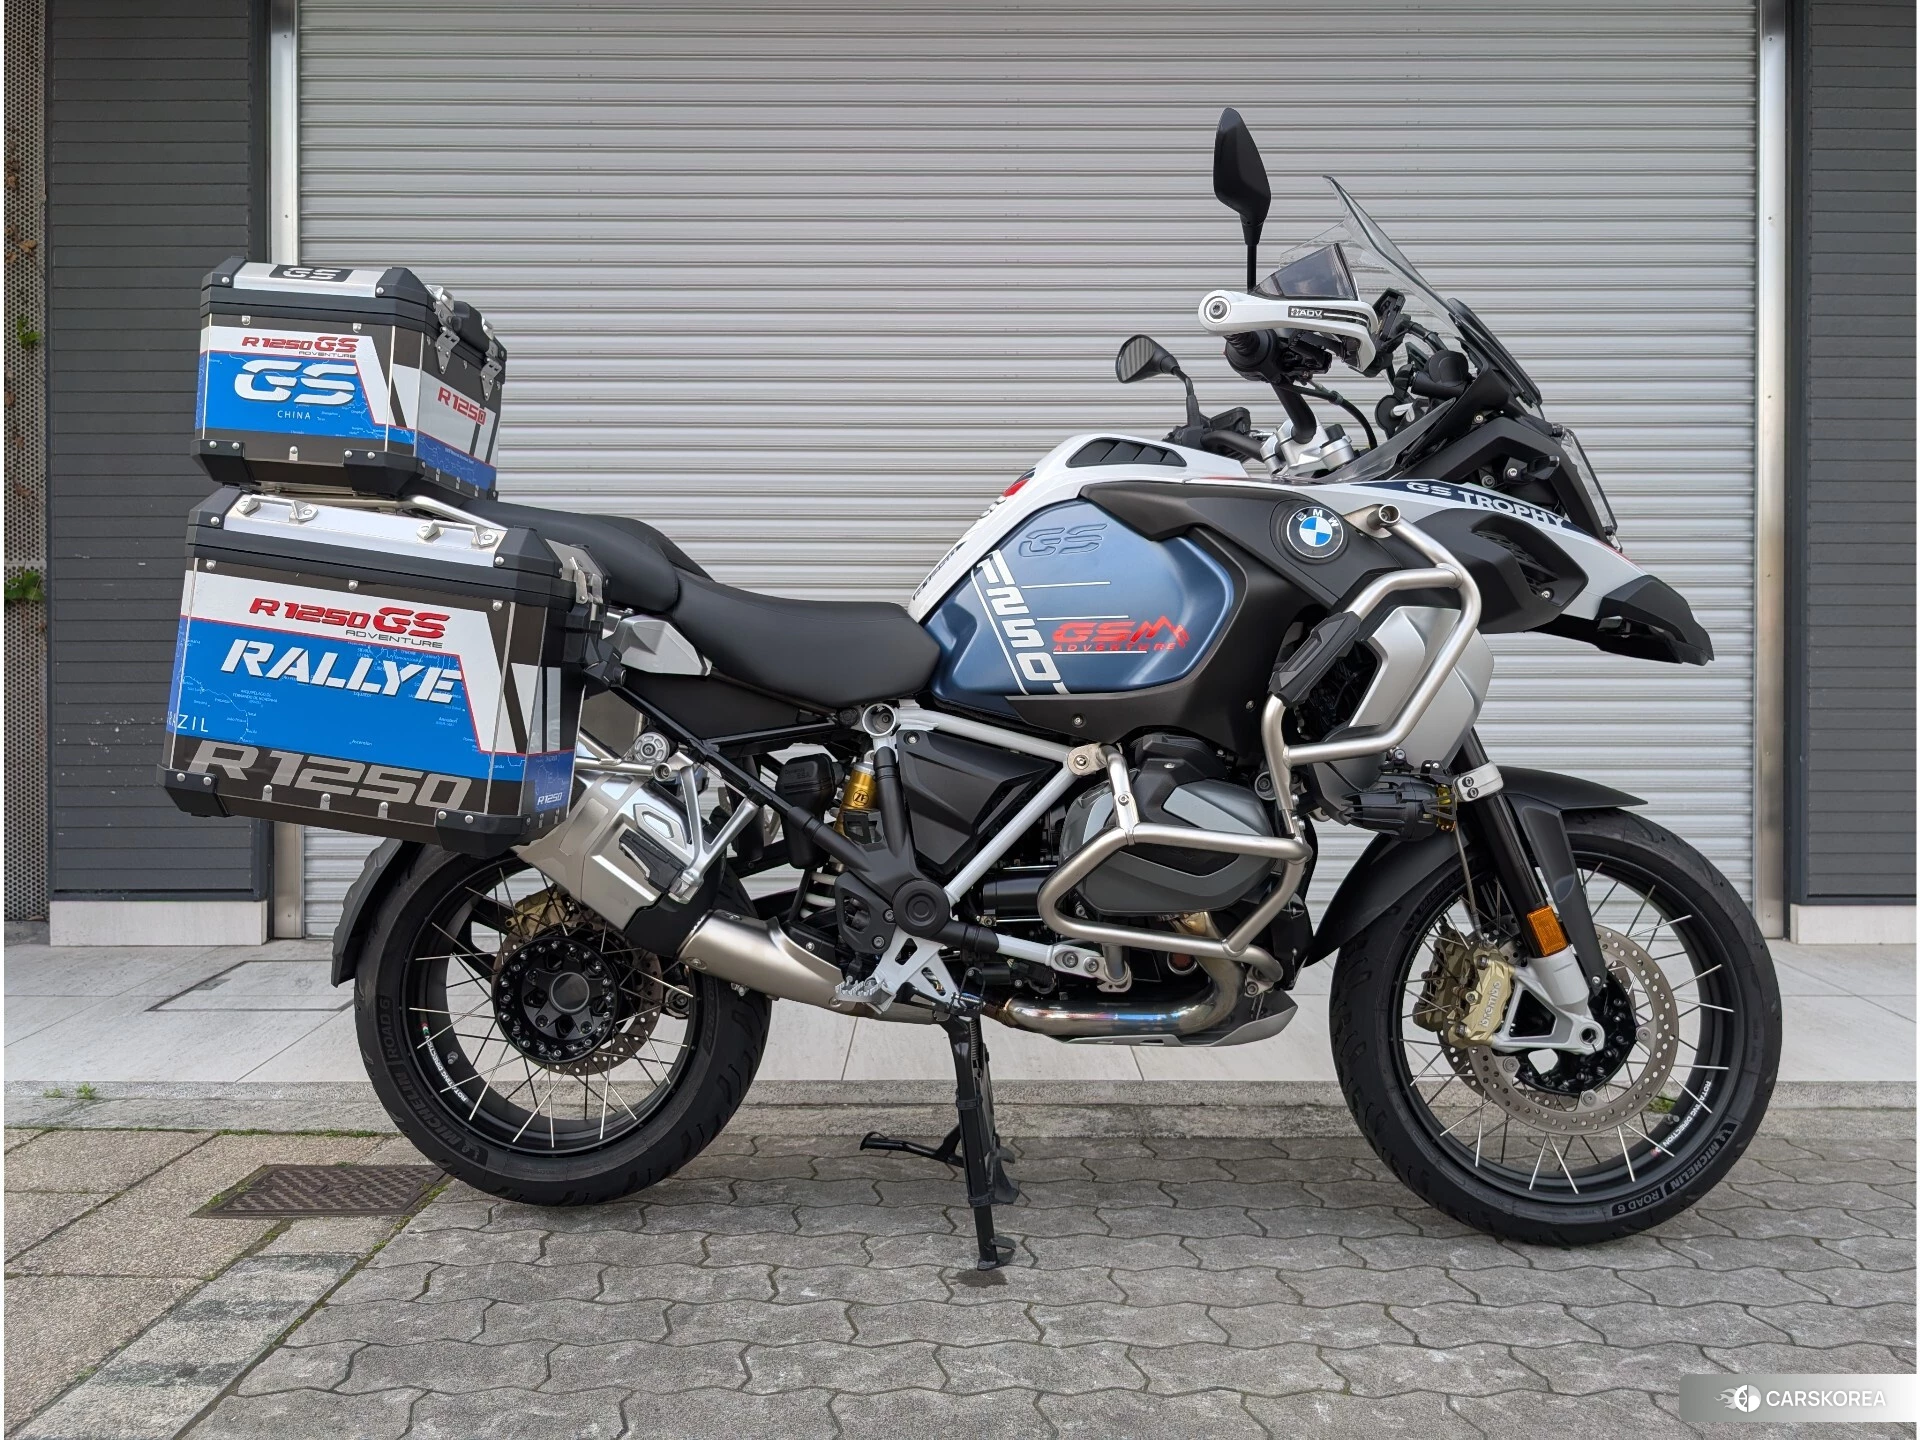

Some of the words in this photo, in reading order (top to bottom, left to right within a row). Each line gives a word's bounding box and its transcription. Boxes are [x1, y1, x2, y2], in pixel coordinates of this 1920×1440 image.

[282, 267, 342, 280] GS
[234, 360, 358, 405] GS
[277, 410, 311, 420] CHINA
[1296, 508, 1340, 528] BMW
[1406, 482, 1451, 496] GS
[1458, 490, 1563, 527] TROPHY
[1019, 523, 1108, 558] GS
[345, 629, 444, 649] ADVENTURE
[1053, 641, 1177, 652] ADVENTURE
[221, 638, 462, 704] RALLYE
[1480, 981, 1501, 1027] brembo
[380, 1013, 395, 1060] ROAD
[395, 1071, 462, 1147] MICHELIN
[1670, 1141, 1720, 1191] MICHELIN
[1628, 1190, 1661, 1209] ROAD
